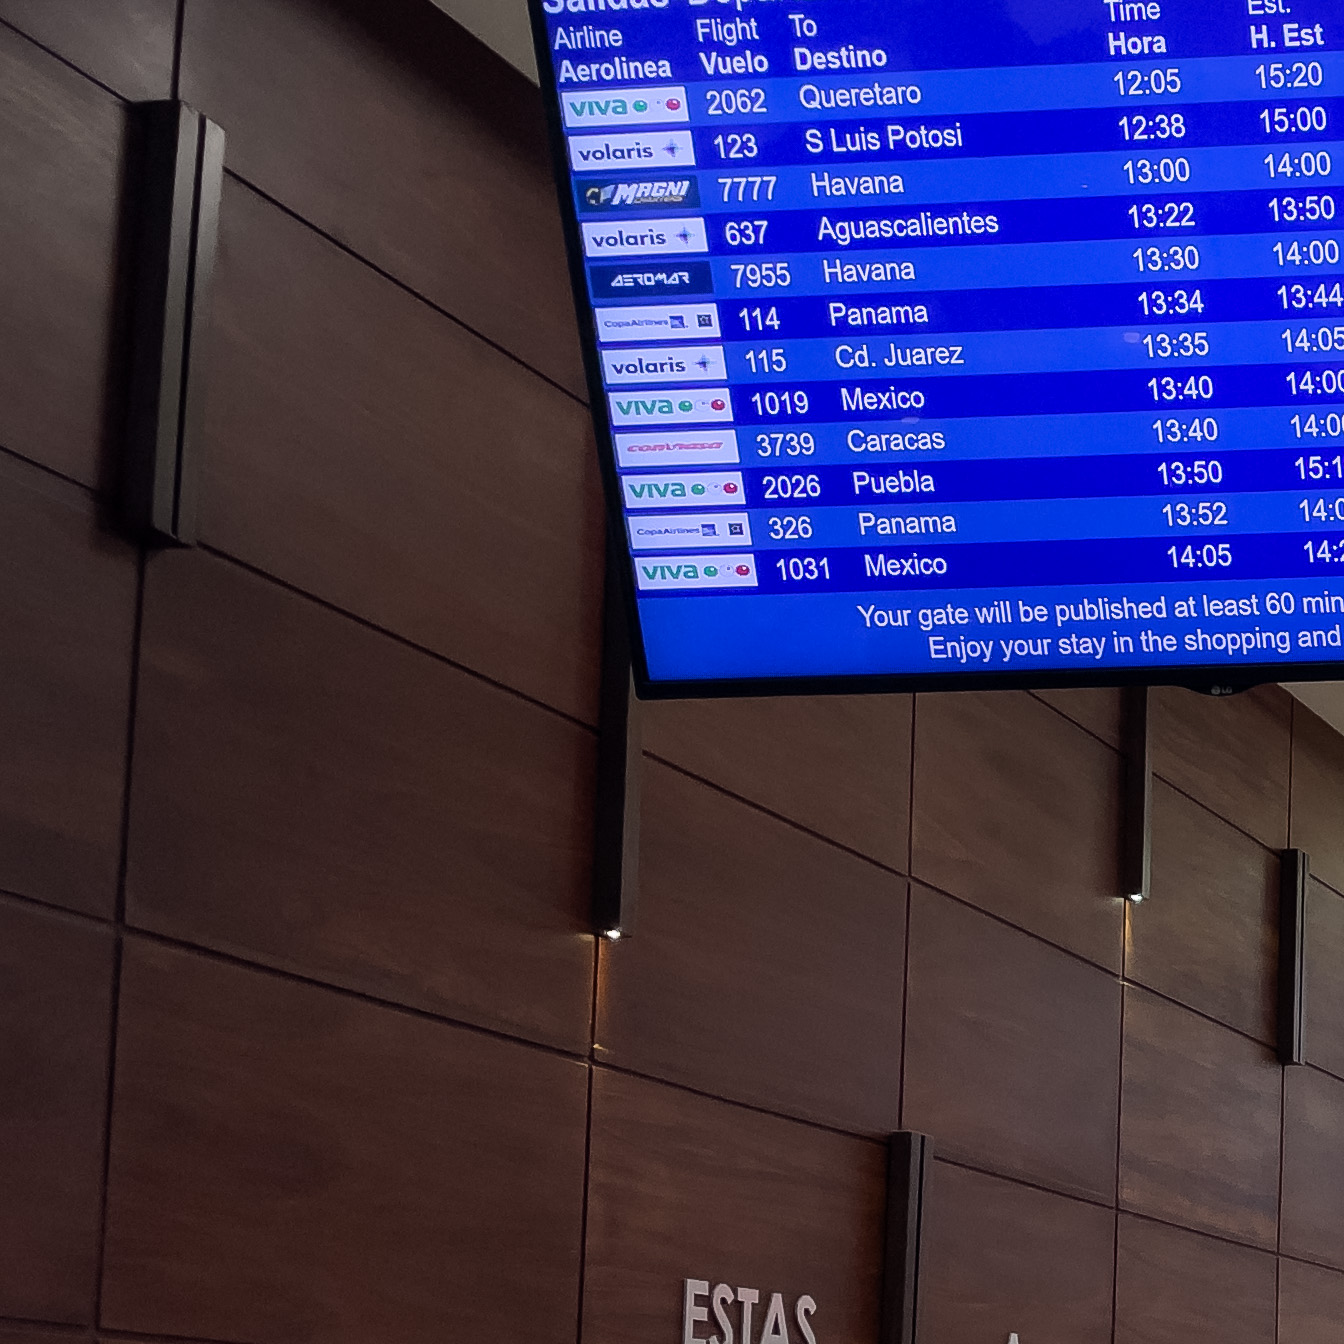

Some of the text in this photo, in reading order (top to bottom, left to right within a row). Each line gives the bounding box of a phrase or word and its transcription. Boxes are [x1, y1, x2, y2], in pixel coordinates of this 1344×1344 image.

[554, 25, 623, 50] Airline
[697, 18, 759, 45] Flight
[788, 13, 817, 38] To
[1103, 0, 1161, 22] Time
[559, 56, 673, 83] Aerolinea
[698, 49, 769, 75] Vuelo
[793, 44, 887, 71] Destino
[1107, 31, 1167, 56] Hora
[1249, 24, 1276, 49] H.
[1282, 23, 1325, 47] Est
[577, 141, 653, 162] volaris
[713, 133, 758, 159] 123
[805, 128, 824, 153] S
[829, 126, 881, 152] Luis
[887, 122, 963, 150] Potosi
[1118, 113, 1186, 141] 12:38
[1259, 106, 1327, 134] 15:00
[591, 228, 666, 248] volaris
[725, 220, 768, 246] 637
[818, 211, 999, 246] Aguascalientes
[1128, 202, 1196, 229] 13:22
[1268, 195, 1335, 222] 13:50
[730, 262, 791, 288] 7955
[822, 258, 916, 283] Havana
[1132, 245, 1199, 272] 13:30
[1272, 239, 1339, 266] 14:00
[739, 306, 781, 331] 114
[828, 302, 929, 327] Panama
[1137, 289, 1205, 316] 13:34
[1277, 282, 1344, 309] 13:44
[762, 474, 821, 499] 2026
[852, 469, 936, 495] Puebla
[1157, 460, 1223, 485] 13:50
[856, 604, 912, 628] Your
[919, 604, 968, 630] gate
[974, 601, 1012, 623] will
[1018, 600, 1049, 623] be
[1055, 595, 1167, 627] published
[1174, 596, 1198, 618] at
[1203, 595, 1260, 616] least
[1266, 592, 1294, 614] 60
